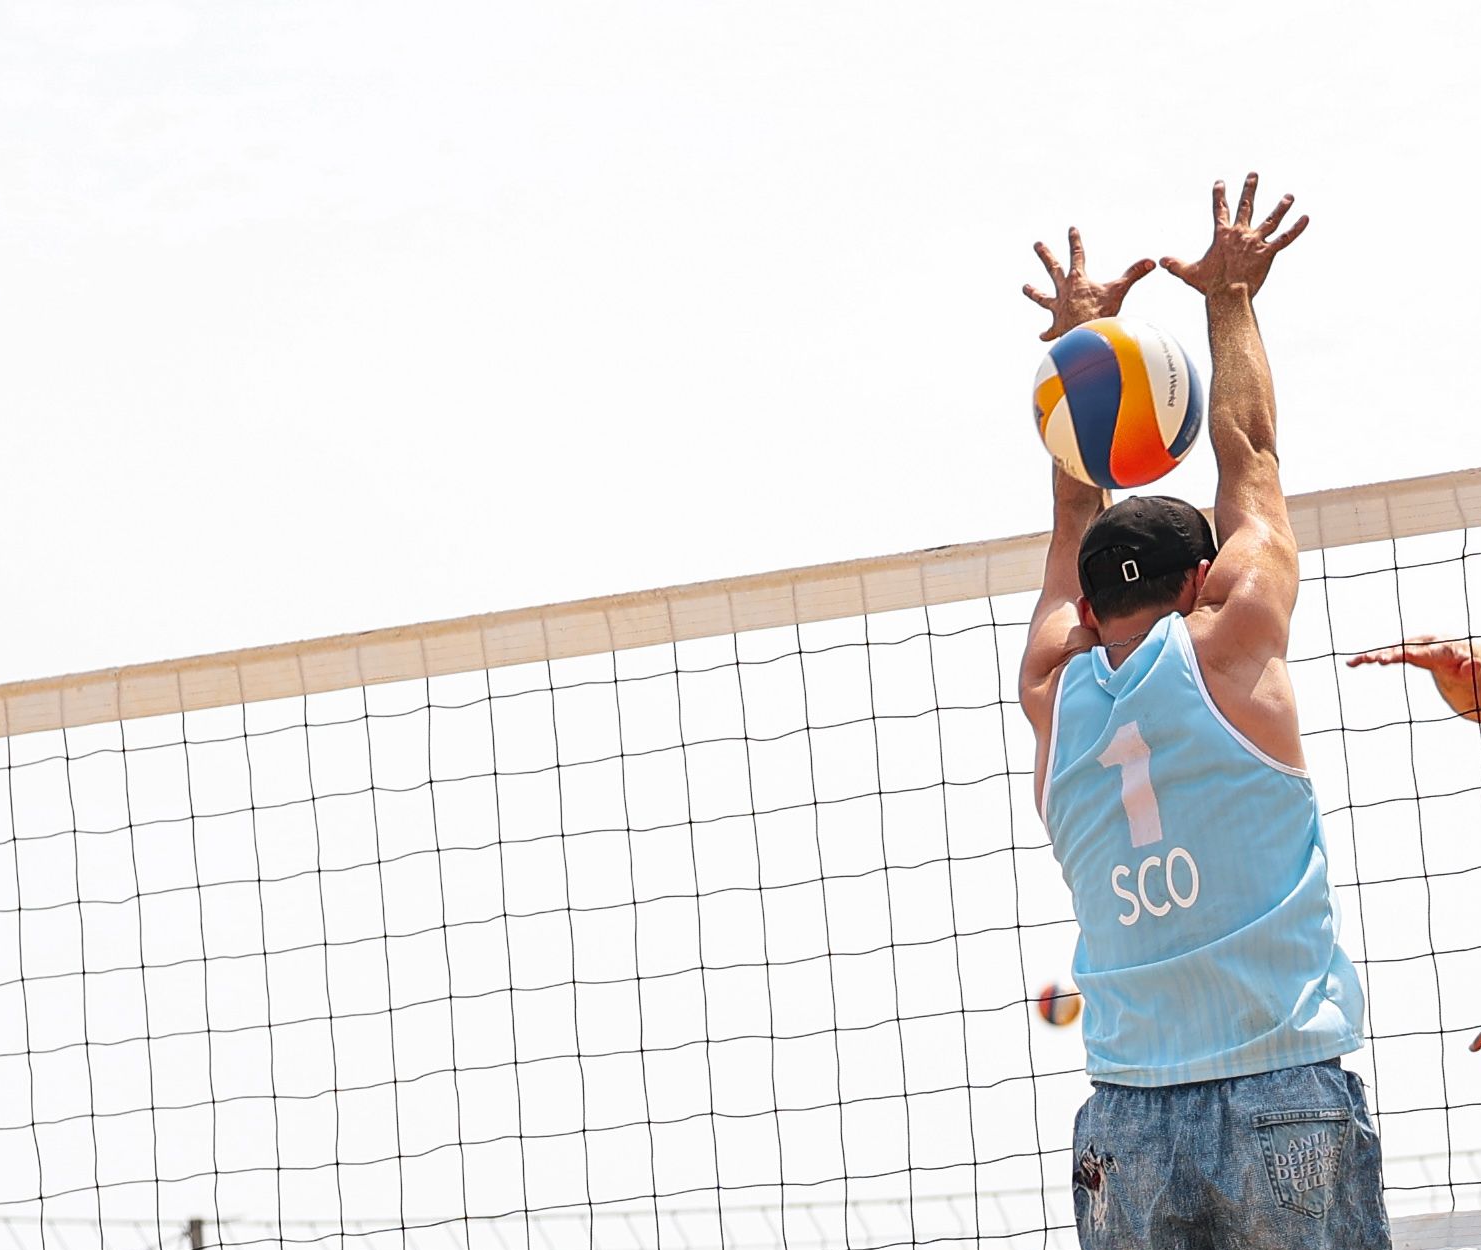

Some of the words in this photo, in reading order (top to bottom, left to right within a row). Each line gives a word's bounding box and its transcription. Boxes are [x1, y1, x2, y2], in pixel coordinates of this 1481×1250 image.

[1096, 720, 1164, 849] 1
[1111, 847, 1200, 926] SCO
[1274, 1144, 1338, 1166] DEFENSE
[1288, 1130, 1327, 1152] ANTI
